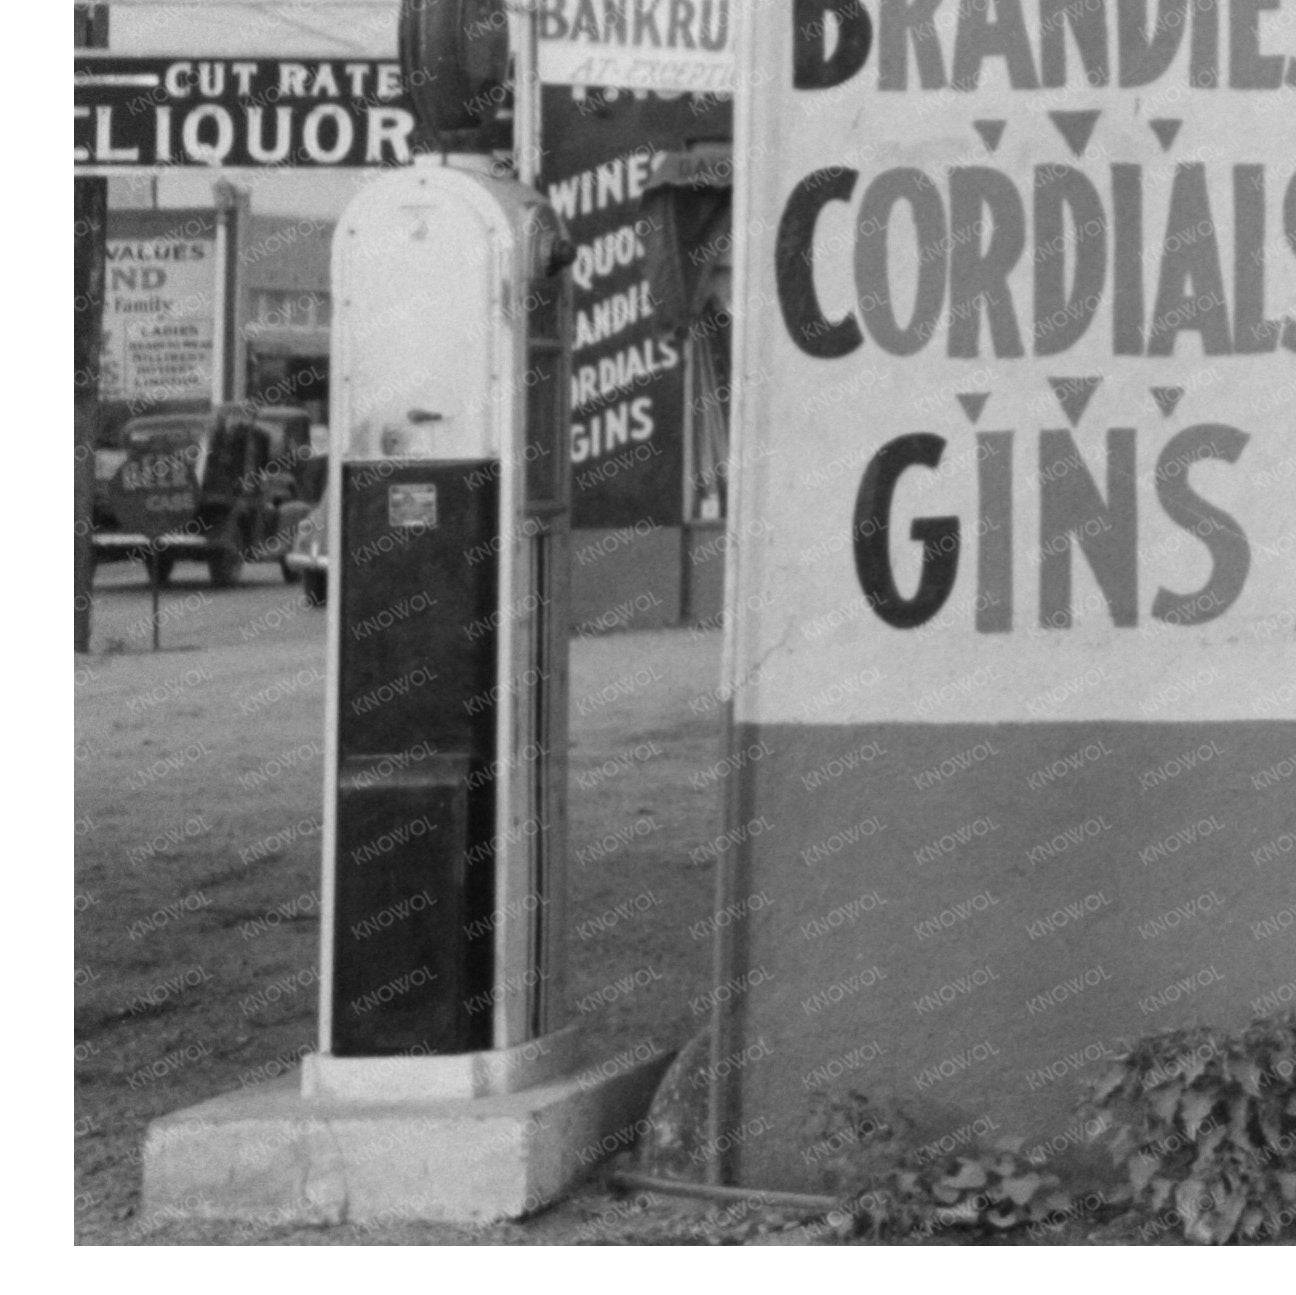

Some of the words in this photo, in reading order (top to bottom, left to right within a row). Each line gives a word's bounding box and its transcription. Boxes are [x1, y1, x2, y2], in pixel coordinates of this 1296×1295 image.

[164, 61, 258, 98] CUT
[278, 63, 402, 98] RATE
[572, 225, 645, 291] QUO
[570, 397, 654, 463] GINS
[852, 423, 1251, 633] GINS
